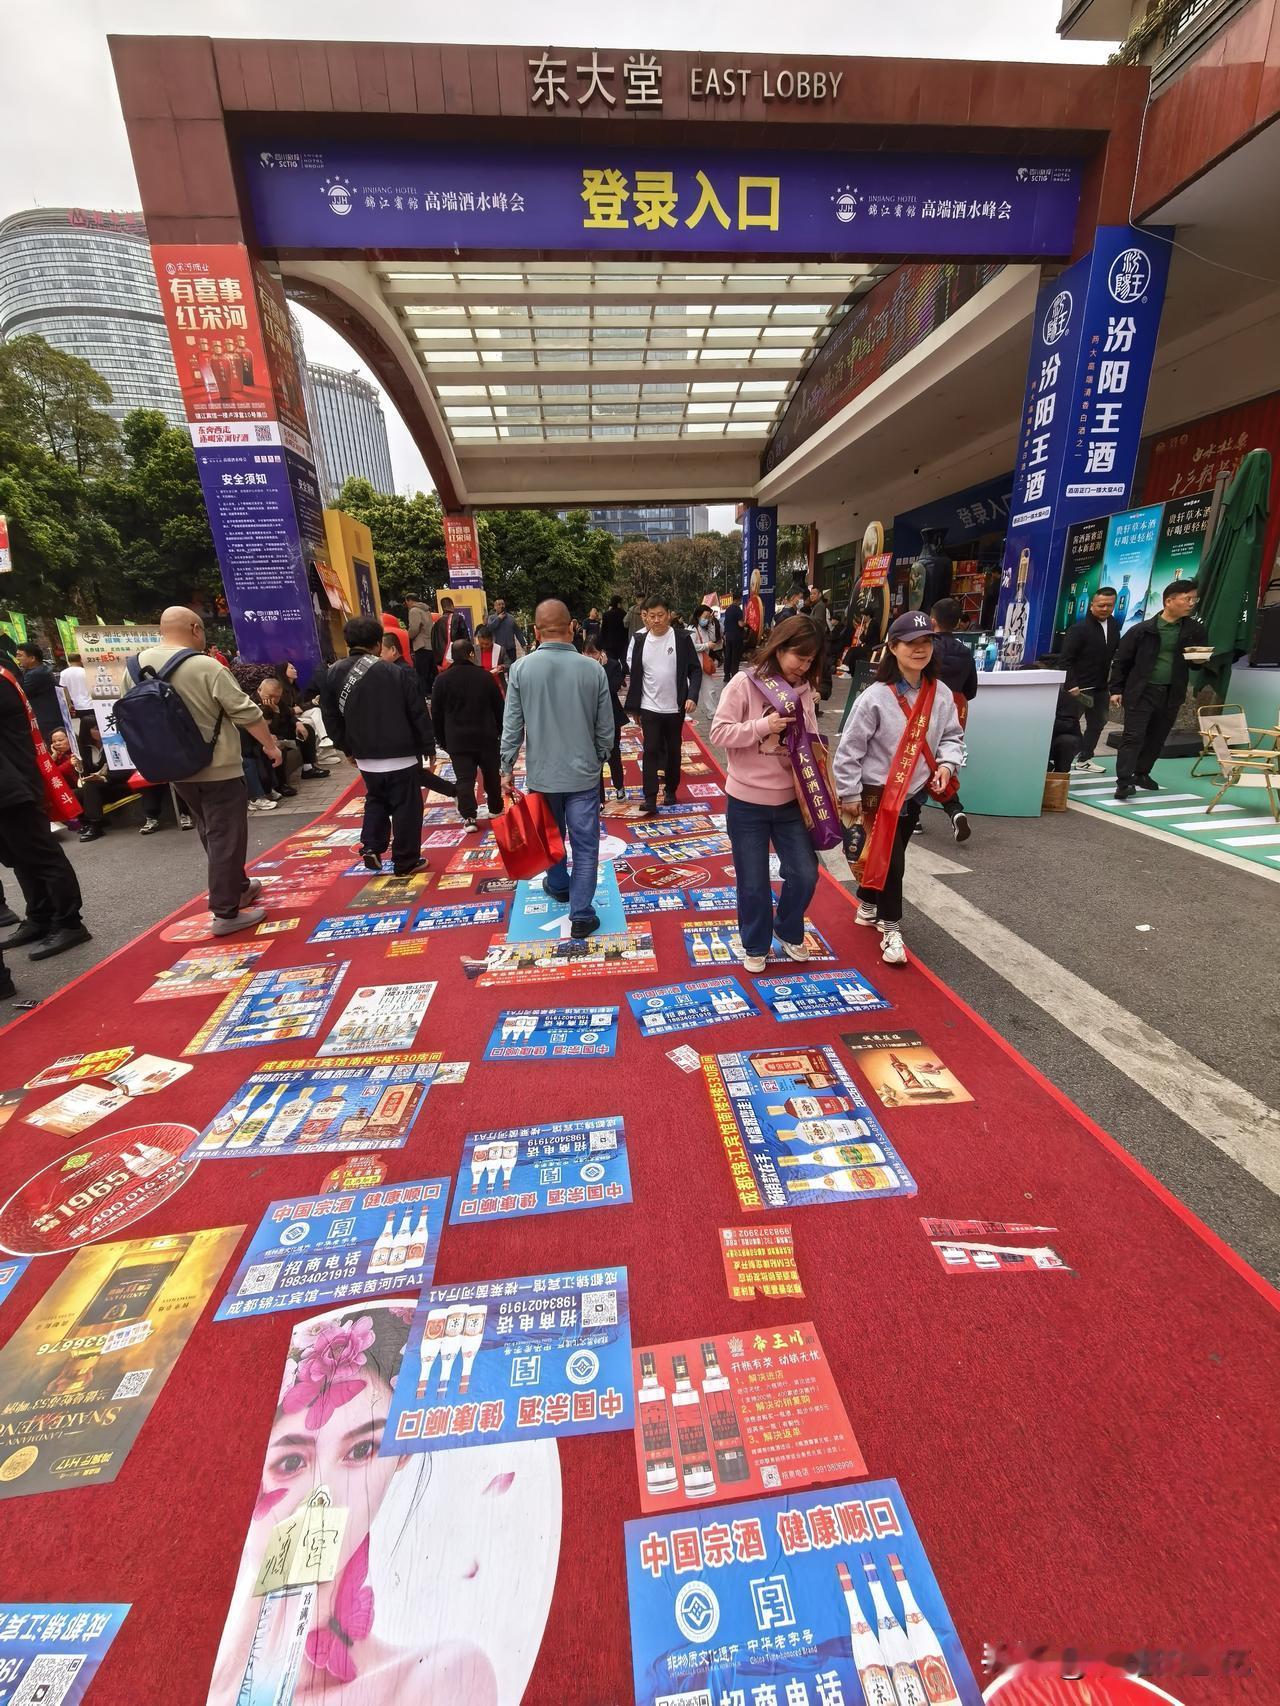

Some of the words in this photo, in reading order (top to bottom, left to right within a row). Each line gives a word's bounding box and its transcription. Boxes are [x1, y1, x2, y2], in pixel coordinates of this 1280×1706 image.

[529, 52, 663, 106] 东大堂
[692, 68, 752, 97] EAST
[763, 71, 843, 99] LOBBY
[424, 190, 525, 213] 高端酒水峰会
[581, 168, 781, 232] 登录入口
[921, 199, 1012, 220] 高端酒水峰会
[168, 277, 243, 304] 有喜事
[175, 304, 249, 331] 红宋河
[1084, 316, 1137, 474] 汾阳王酒
[1023, 352, 1061, 504] 汾阳王酒
[221, 472, 268, 485] 安全须知
[260, 1052, 443, 1072] 成都锦江宾馆南楼5楼530房间
[701, 1055, 762, 1207] 成都锦江宾馆南楼5楼530房间
[526, 1140, 587, 1158] 招商电话
[56, 1169, 130, 1216] 1965
[273, 1196, 355, 1223] 中国宗酒
[362, 1184, 442, 1210] 健康顺口
[460, 1192, 538, 1216] 健康顺口
[547, 1182, 623, 1206] 中国宗酒
[284, 1250, 363, 1275] 招商电话
[499, 1295, 577, 1314] 19834021919
[496, 1309, 577, 1335] 招商电话
[395, 1398, 505, 1440] 健康顺口
[517, 1387, 624, 1428] 中国宗酒
[640, 1519, 769, 1578] 中国宗酒
[776, 1498, 903, 1555] 健康顺口
[746, 1629, 814, 1655] 中华老字号
[666, 1644, 740, 1672] 非物质文化遗产
